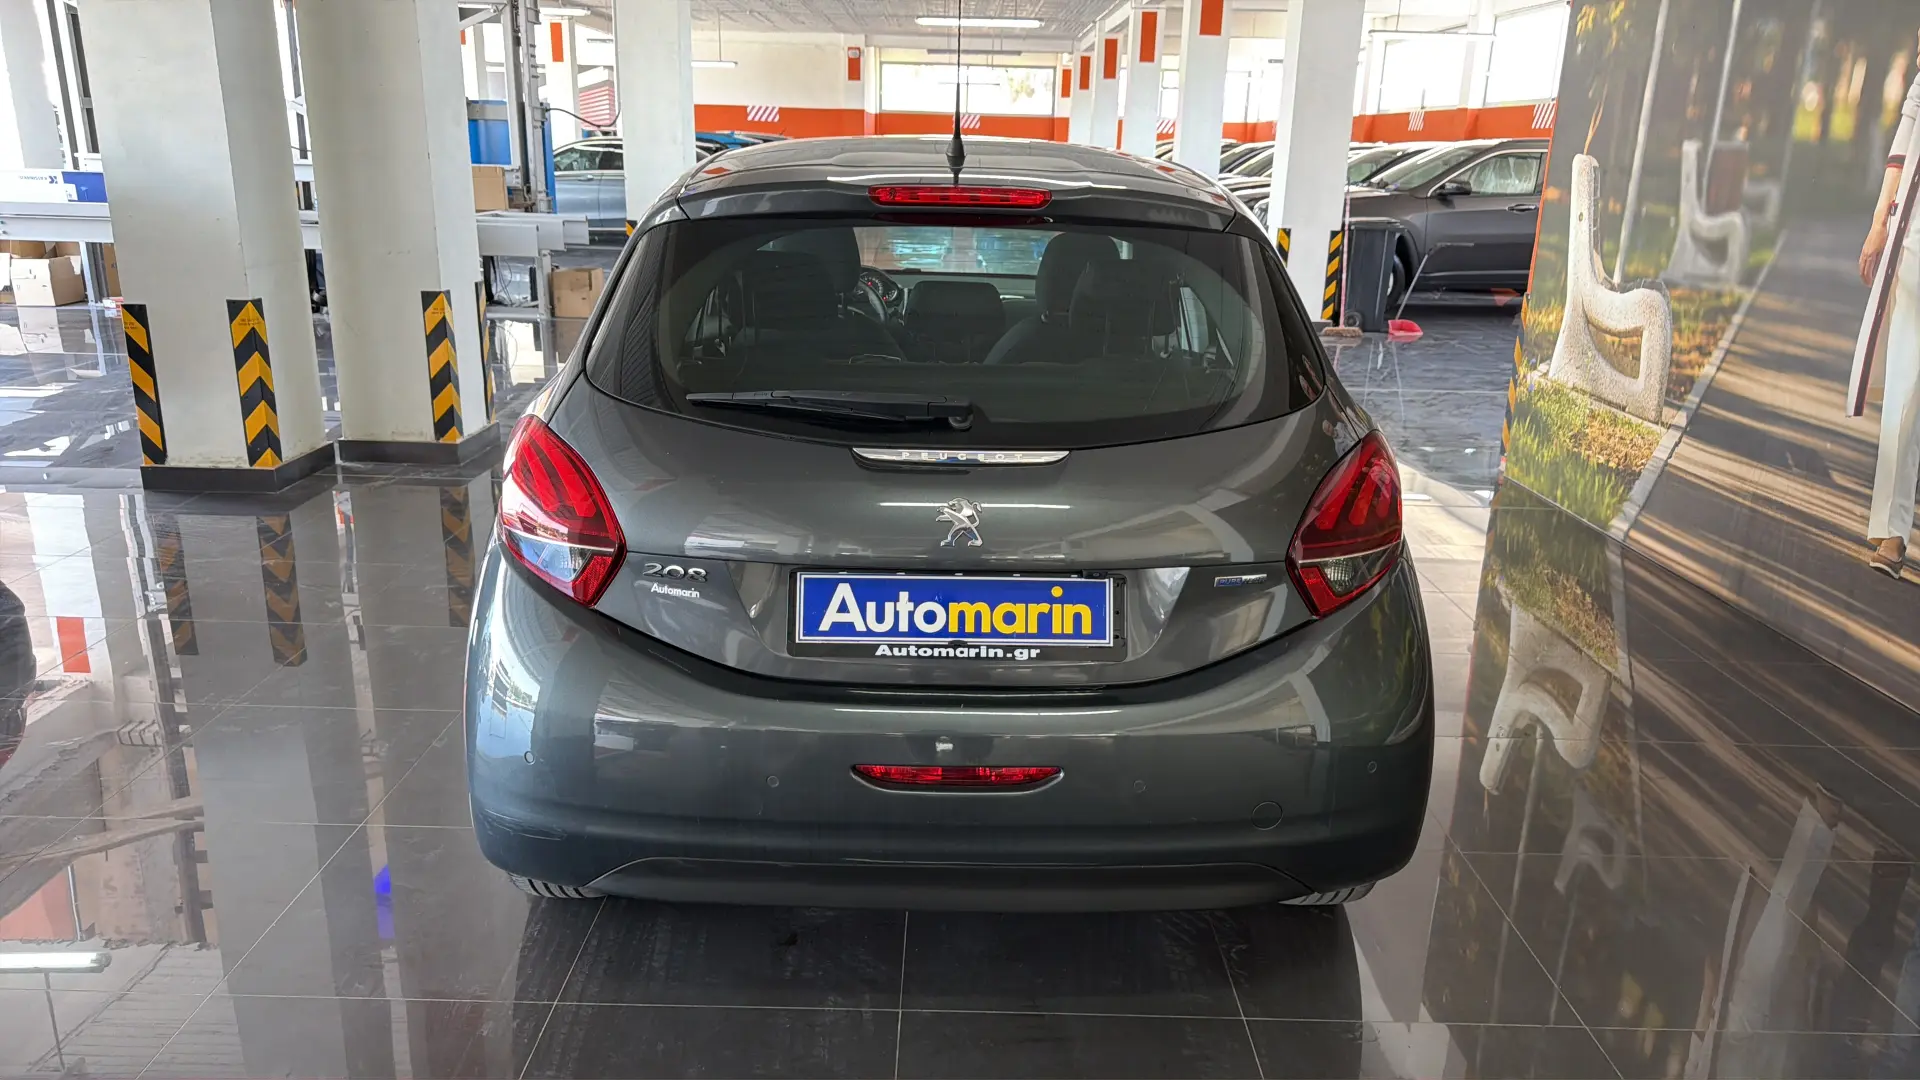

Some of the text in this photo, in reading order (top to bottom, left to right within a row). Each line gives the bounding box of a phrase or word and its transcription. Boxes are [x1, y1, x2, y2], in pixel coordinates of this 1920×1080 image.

[901, 452, 1024, 461] PEUGEOT
[643, 563, 707, 582] 208
[651, 583, 699, 598] Automarin
[818, 582, 1092, 634] Automarin
[874, 644, 1041, 660] Automarin.gr
